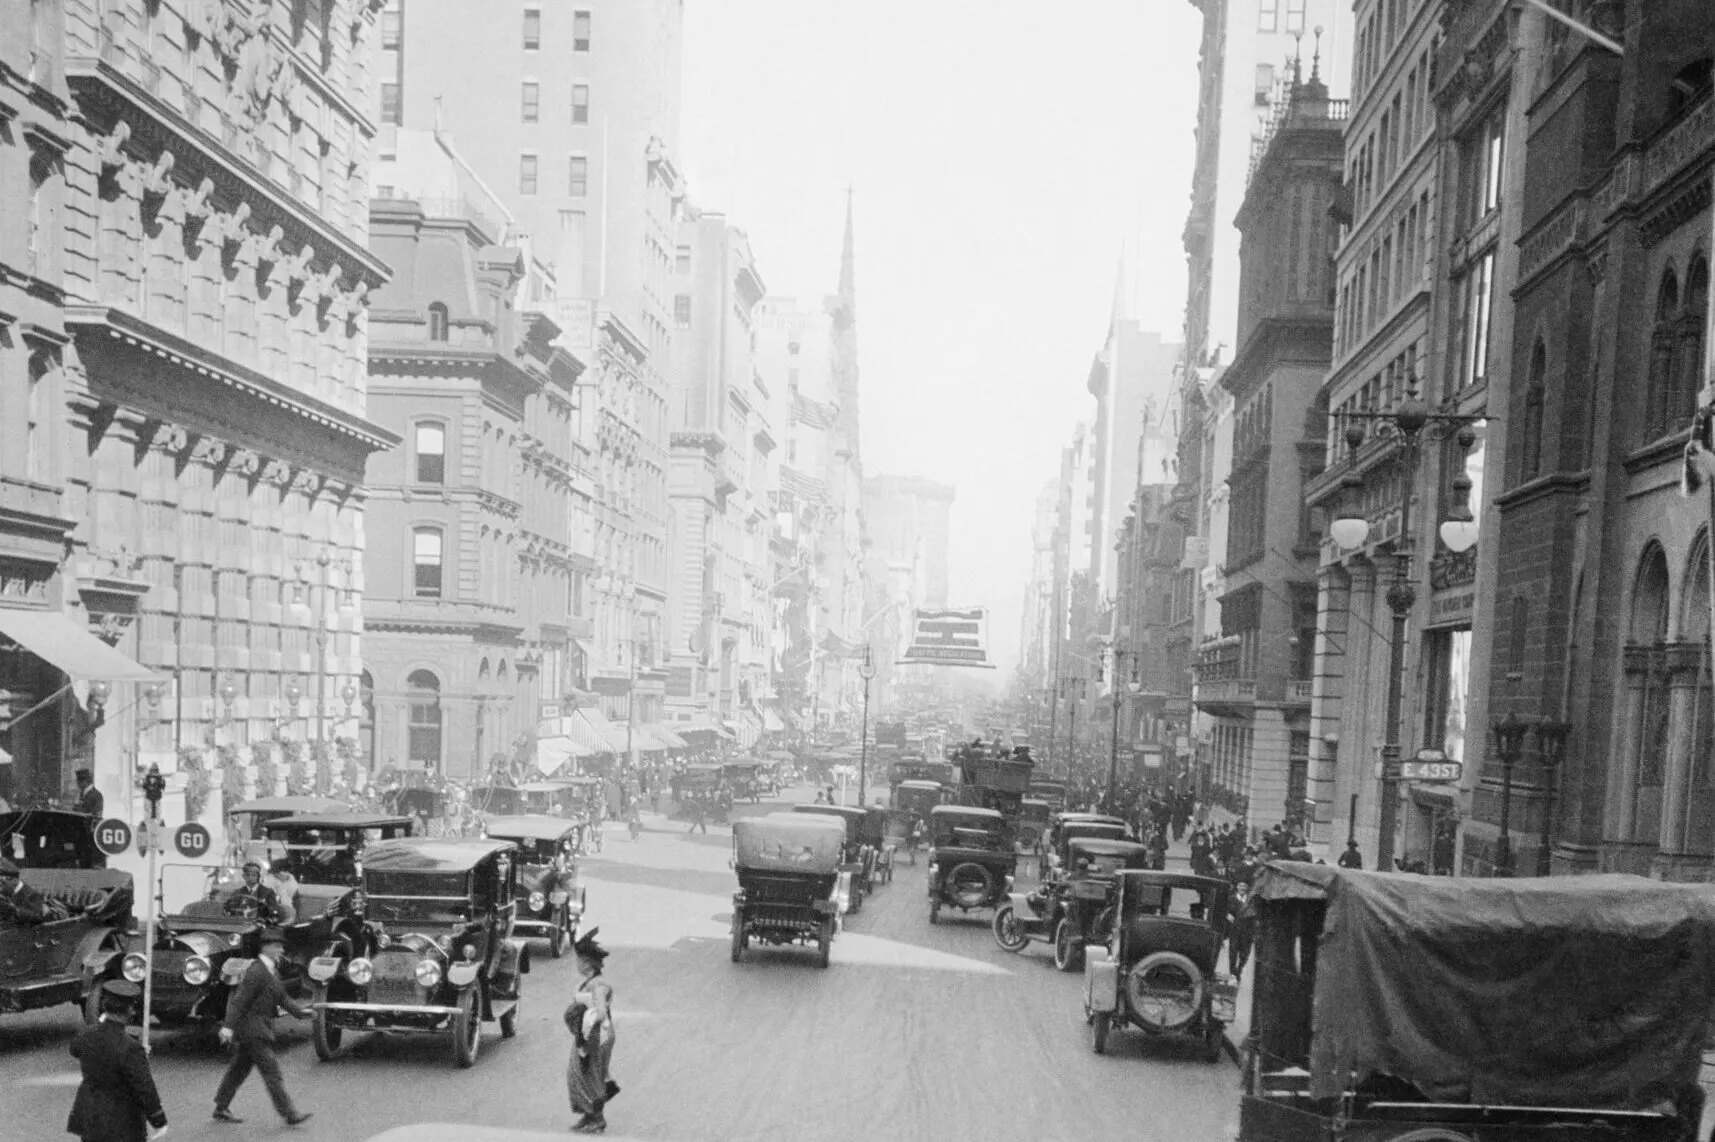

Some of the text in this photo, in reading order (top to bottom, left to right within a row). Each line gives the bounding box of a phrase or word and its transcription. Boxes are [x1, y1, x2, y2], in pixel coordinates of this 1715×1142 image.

[1403, 762, 1415, 777] E
[102, 828, 125, 845] GO
[180, 831, 204, 848] GO
